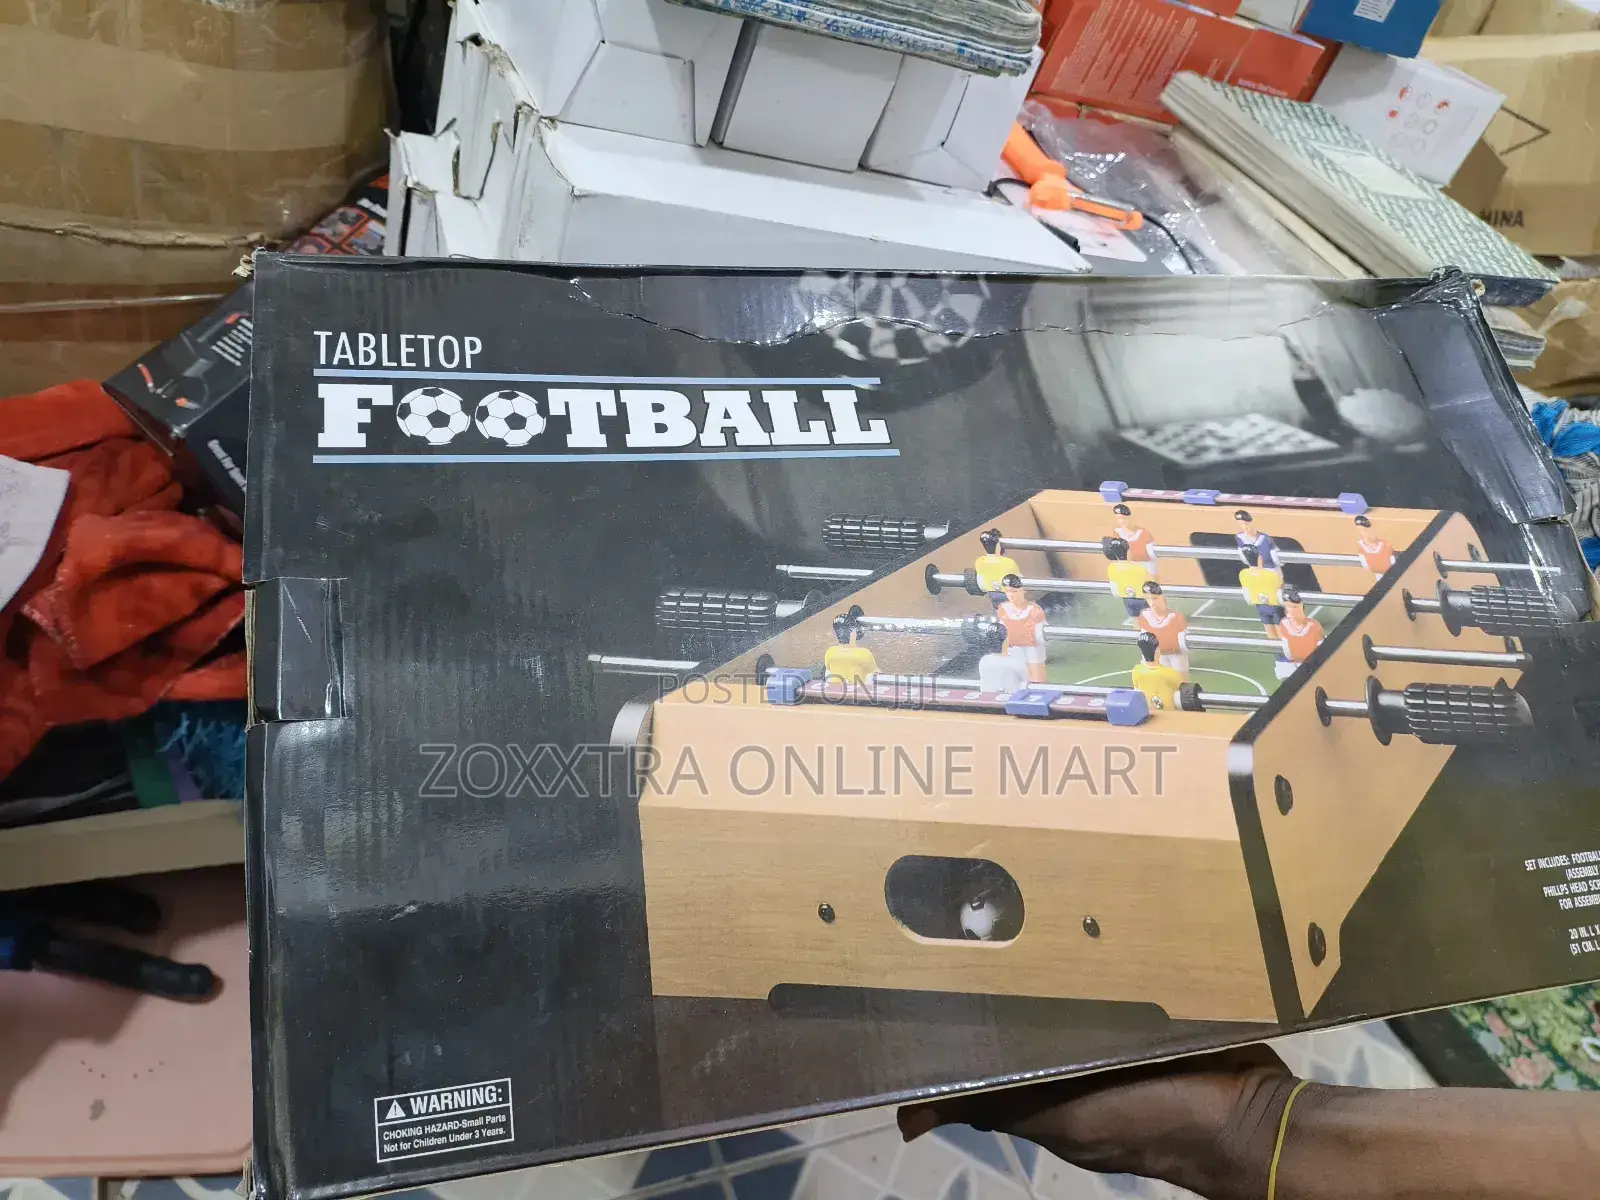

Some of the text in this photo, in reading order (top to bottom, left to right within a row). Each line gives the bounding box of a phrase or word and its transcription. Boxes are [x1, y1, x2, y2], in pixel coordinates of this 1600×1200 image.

[313, 330, 483, 369] TABLETOP
[316, 383, 893, 449] FOOTBALL
[1524, 859, 1537, 871] SET
[1538, 854, 1571, 869] INCLUDES:
[1565, 864, 1599, 880] (ASSEMBLY
[1569, 881, 1588, 893] HEAD
[1558, 897, 1574, 910] FOR
[1568, 928, 1579, 940] 20
[1569, 942, 1581, 956] (51
[409, 1085, 503, 1116] WARNING:
[383, 1113, 507, 1141] CHOKING HAZARD-Small Parts
[383, 1126, 507, 1153] Not for Children Under 3 Years.
